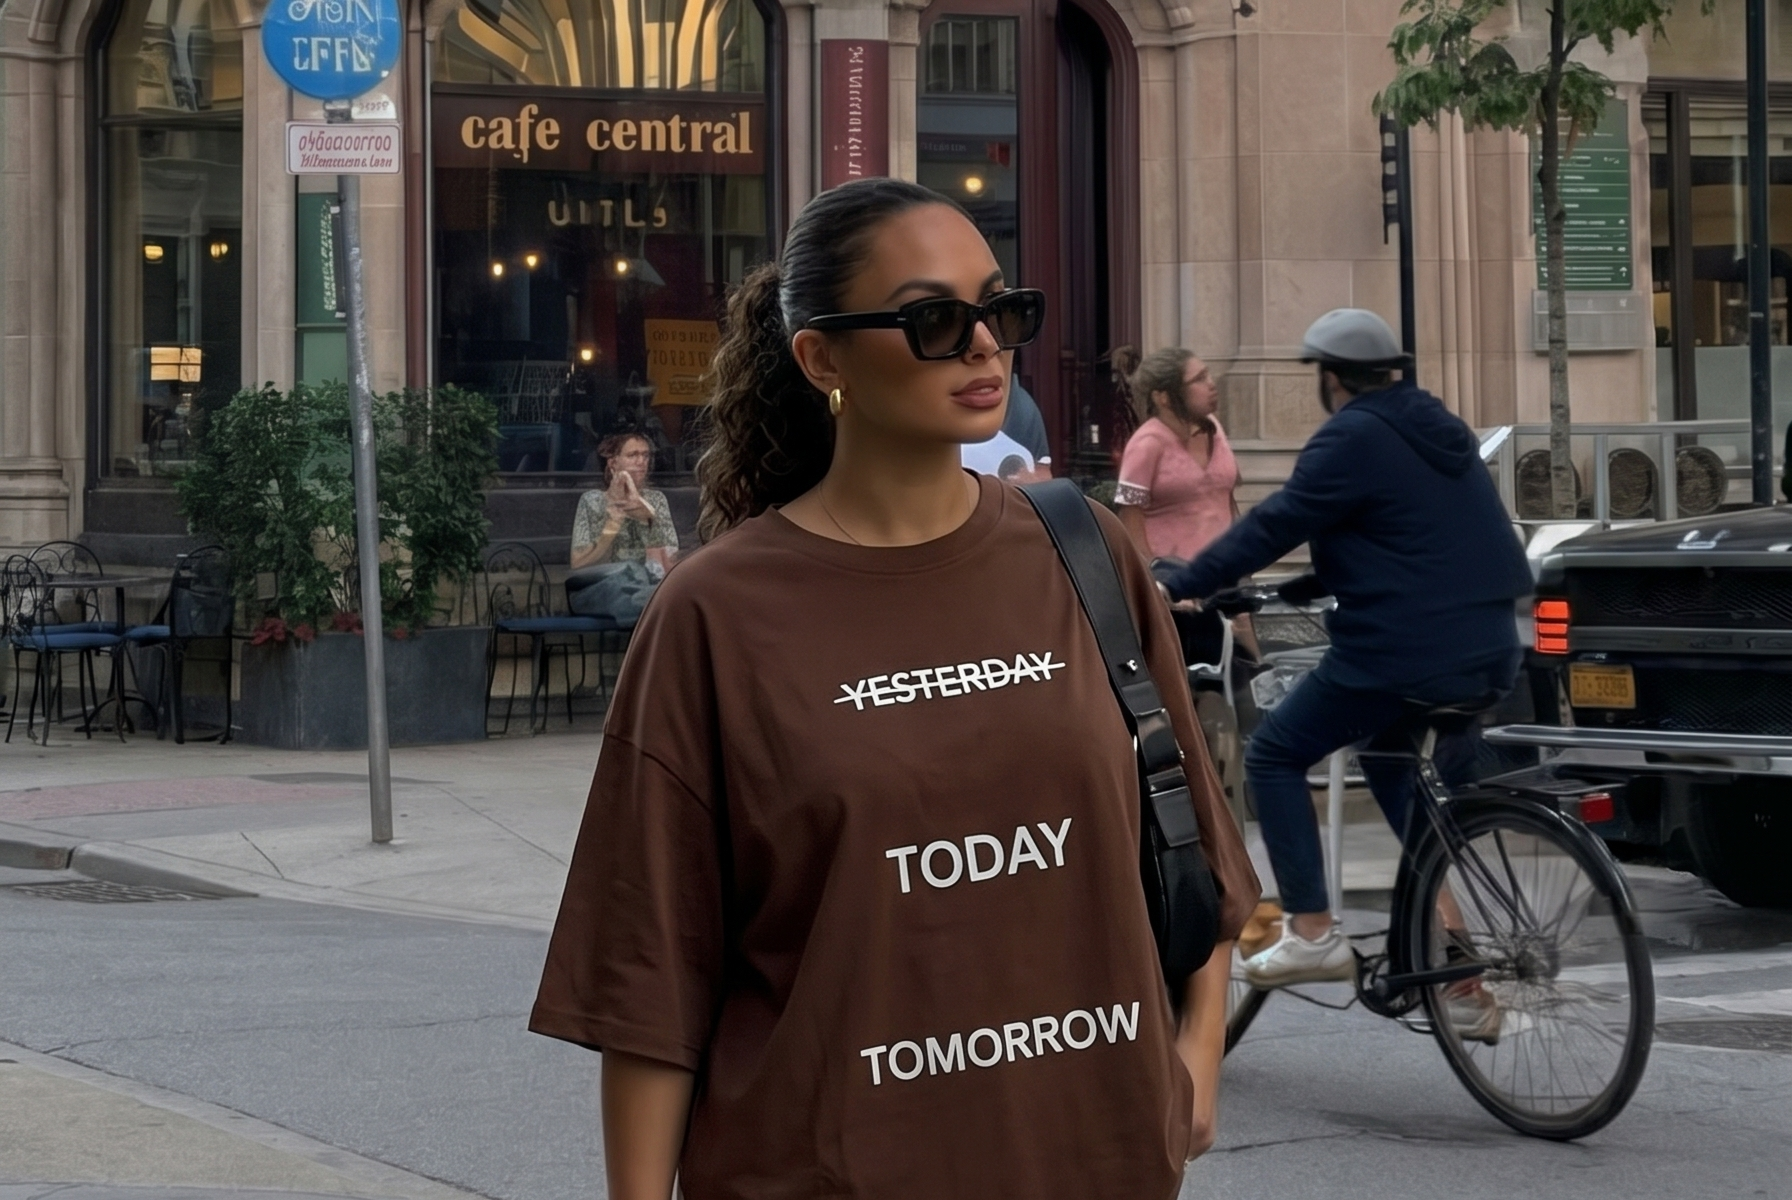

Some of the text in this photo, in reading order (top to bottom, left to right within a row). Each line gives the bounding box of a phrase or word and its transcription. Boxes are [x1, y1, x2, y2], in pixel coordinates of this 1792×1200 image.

[460, 104, 753, 164] cafe central
[839, 651, 1055, 711] YESTERDAY
[885, 817, 1073, 894] TODAY
[860, 1001, 1141, 1086] TOMORROW
